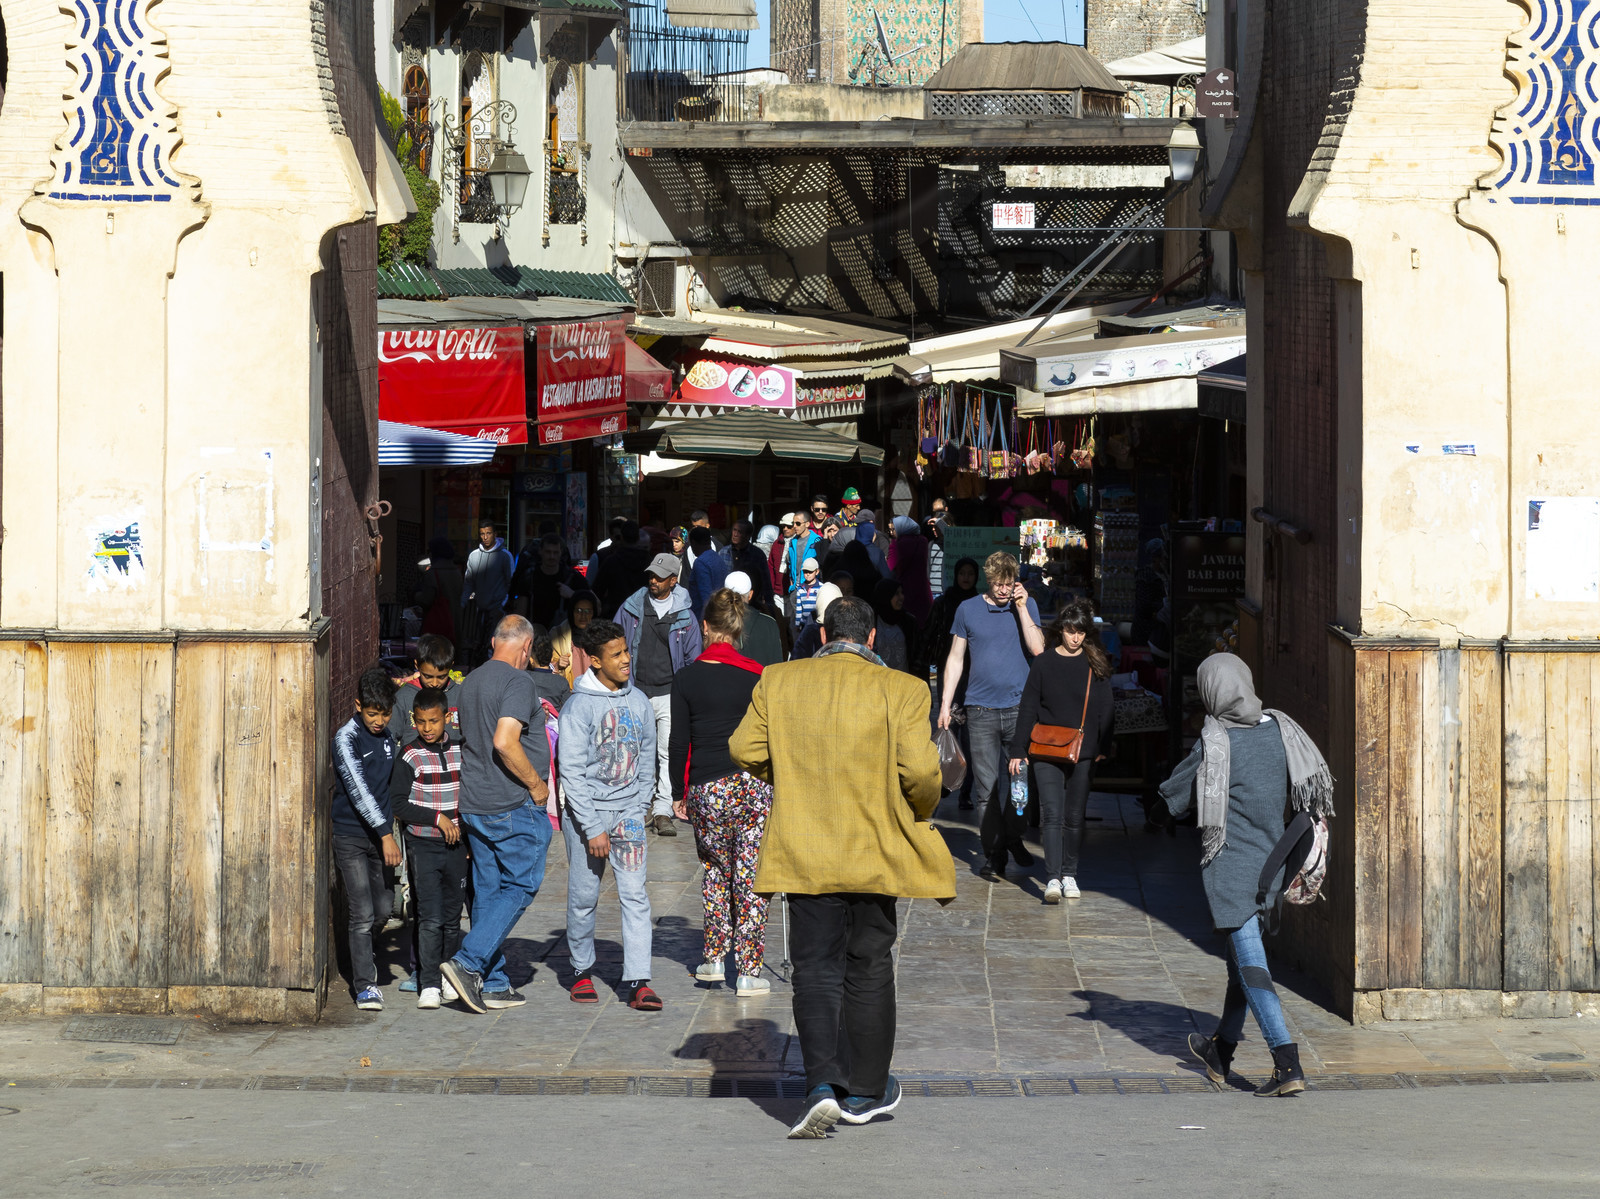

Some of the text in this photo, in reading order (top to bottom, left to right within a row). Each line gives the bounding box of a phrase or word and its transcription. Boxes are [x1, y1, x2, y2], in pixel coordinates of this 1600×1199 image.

[993, 205, 1033, 225] 中华餐厅
[542, 381, 577, 409] RESTAURANT
[576, 379, 584, 403] LA
[584, 377, 606, 402] KASBAH
[605, 376, 613, 399] DE
[1187, 569, 1246, 580] BAB BOU
[1187, 585, 1228, 593] Restaurant
